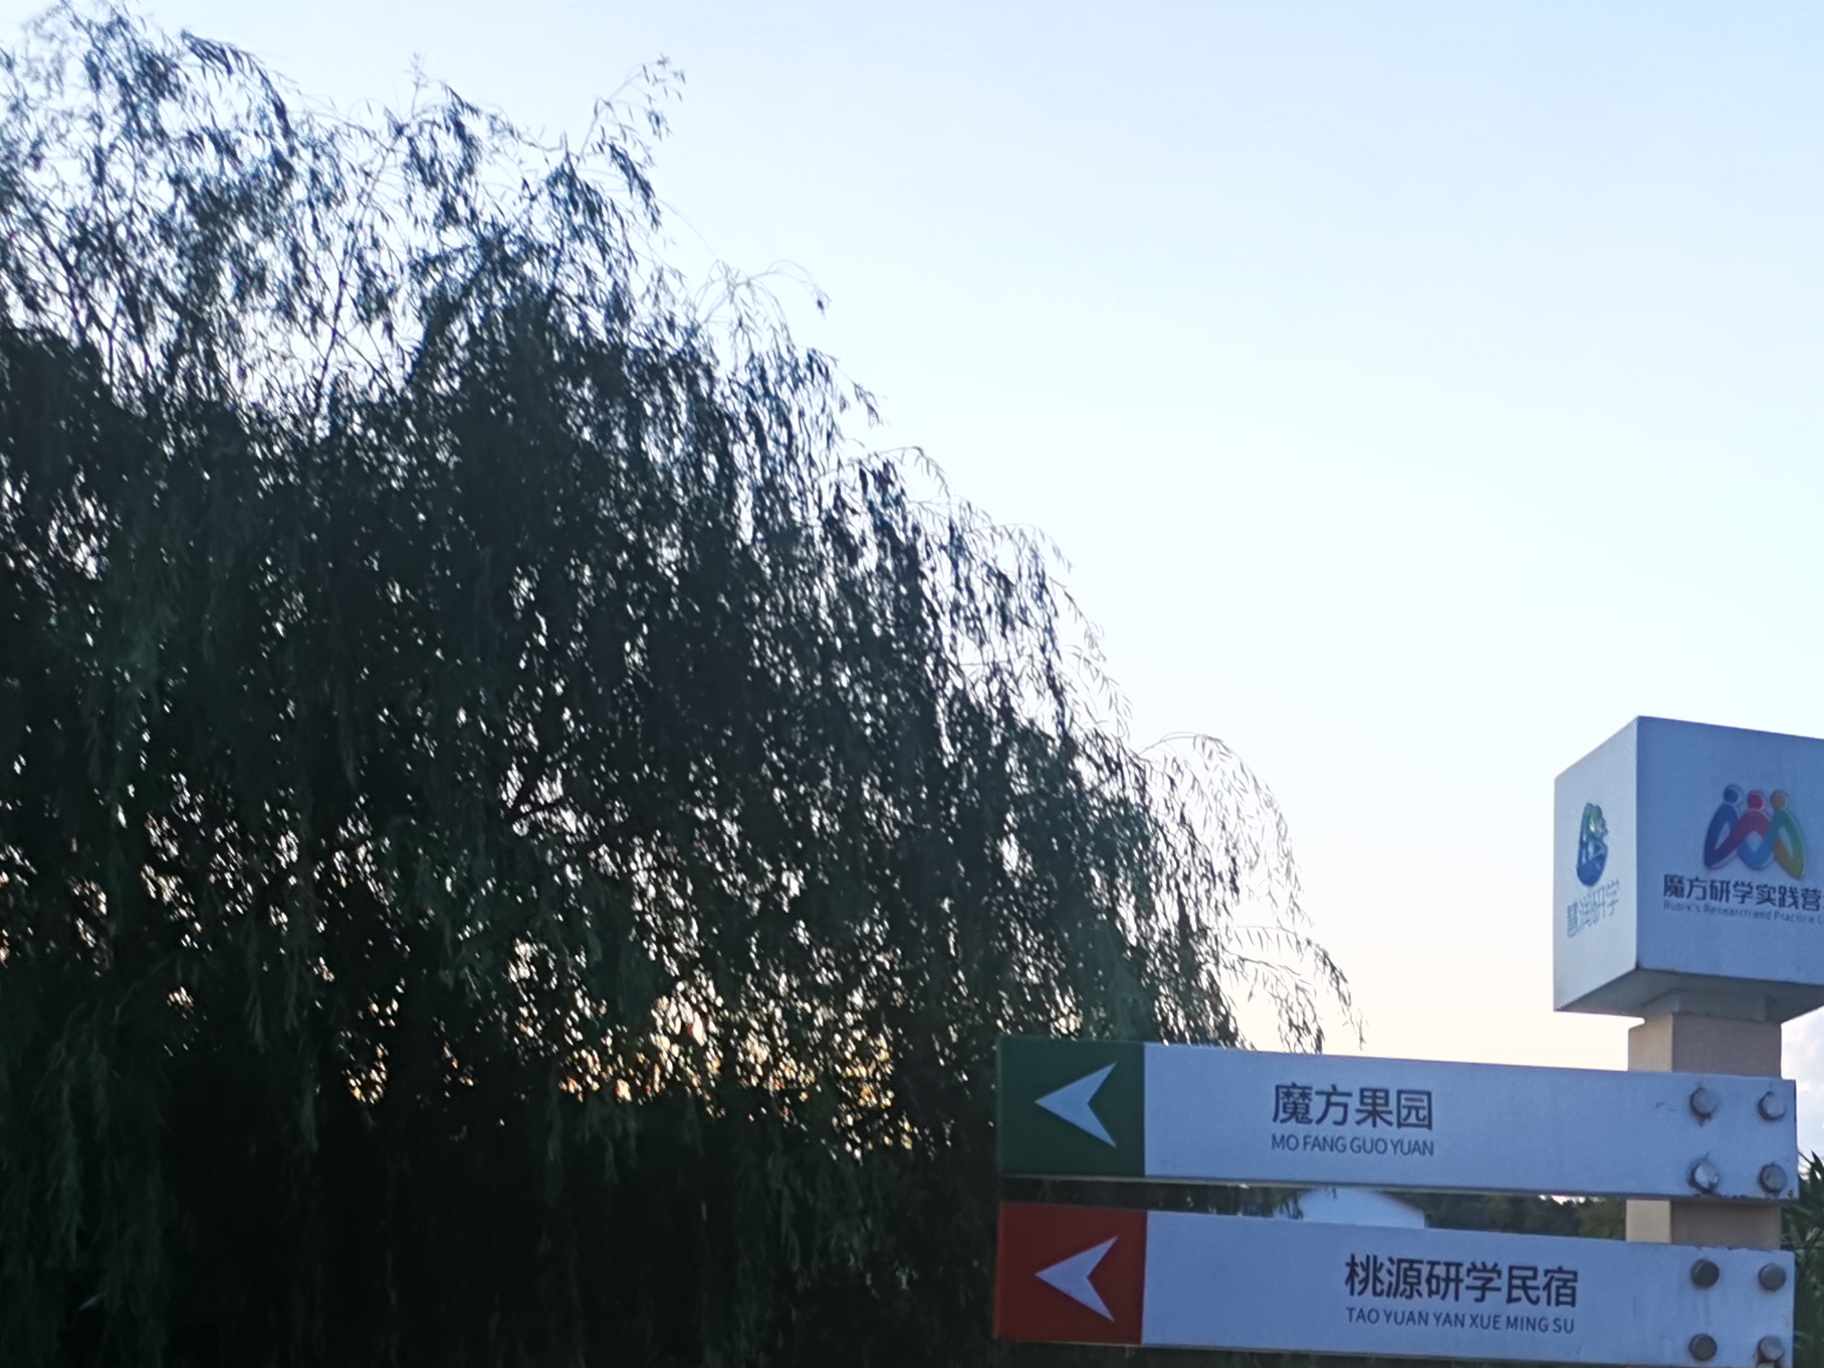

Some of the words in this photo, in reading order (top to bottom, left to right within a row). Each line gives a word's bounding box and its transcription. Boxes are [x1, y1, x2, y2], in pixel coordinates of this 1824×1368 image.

[1703, 903, 1750, 918] Research
[1753, 908, 1771, 921] and
[1774, 910, 1815, 924] Practice
[1271, 1082, 1434, 1131] 魔方果园
[1271, 1133, 1300, 1152] MO
[1303, 1134, 1347, 1154] FANG
[1350, 1136, 1388, 1155] GUO
[1390, 1138, 1435, 1157] YUAN
[1344, 1253, 1579, 1308] 桃源研学民宿
[1345, 1306, 1380, 1325] TAO
[1383, 1309, 1430, 1327] YUAN
[1433, 1311, 1467, 1329] YAN
[1469, 1313, 1502, 1331] XUE
[1505, 1315, 1550, 1333] MING
[1552, 1317, 1576, 1335] SU
